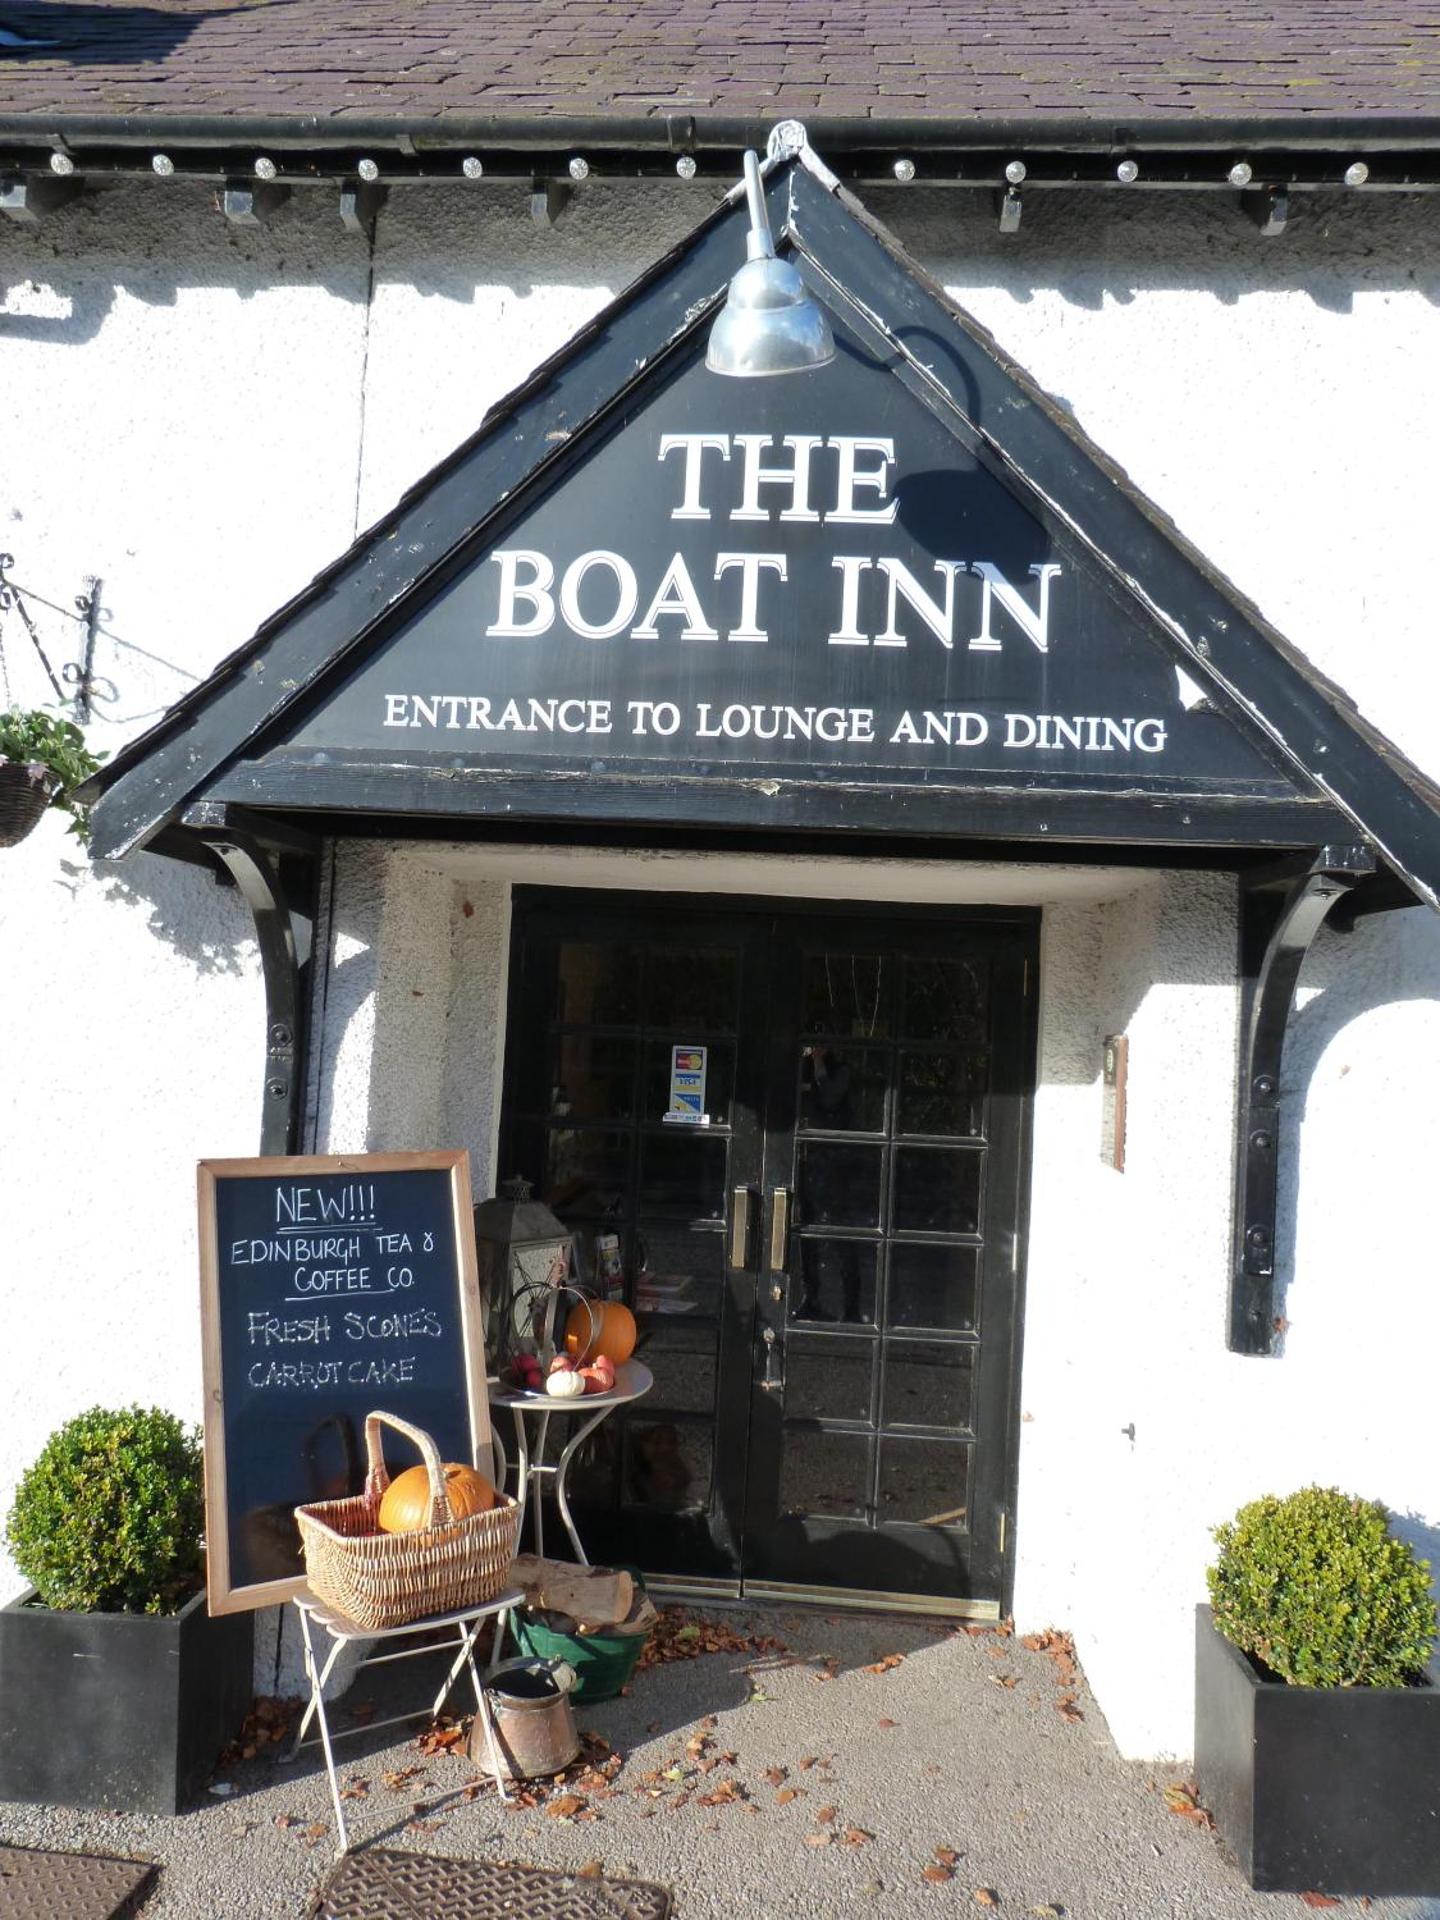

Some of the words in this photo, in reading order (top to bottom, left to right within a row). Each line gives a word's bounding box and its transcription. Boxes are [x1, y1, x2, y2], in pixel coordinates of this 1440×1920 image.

[656, 432, 902, 526] THE
[485, 549, 790, 643] BOAT
[827, 555, 1063, 653] INN
[383, 694, 614, 735] ENTRANCE
[627, 702, 682, 736] TO
[696, 706, 876, 744] LOUNGE
[889, 711, 990, 747] AND
[1003, 714, 1169, 754] DINING
[275, 1184, 376, 1223] NEW!!!
[231, 1236, 361, 1266] EDINBURGH
[375, 1233, 413, 1255] TEA
[294, 1266, 372, 1292] COFFEE
[247, 1311, 332, 1346] FRESH
[248, 1361, 342, 1389] CARROT
[347, 1356, 416, 1385] CAKE
